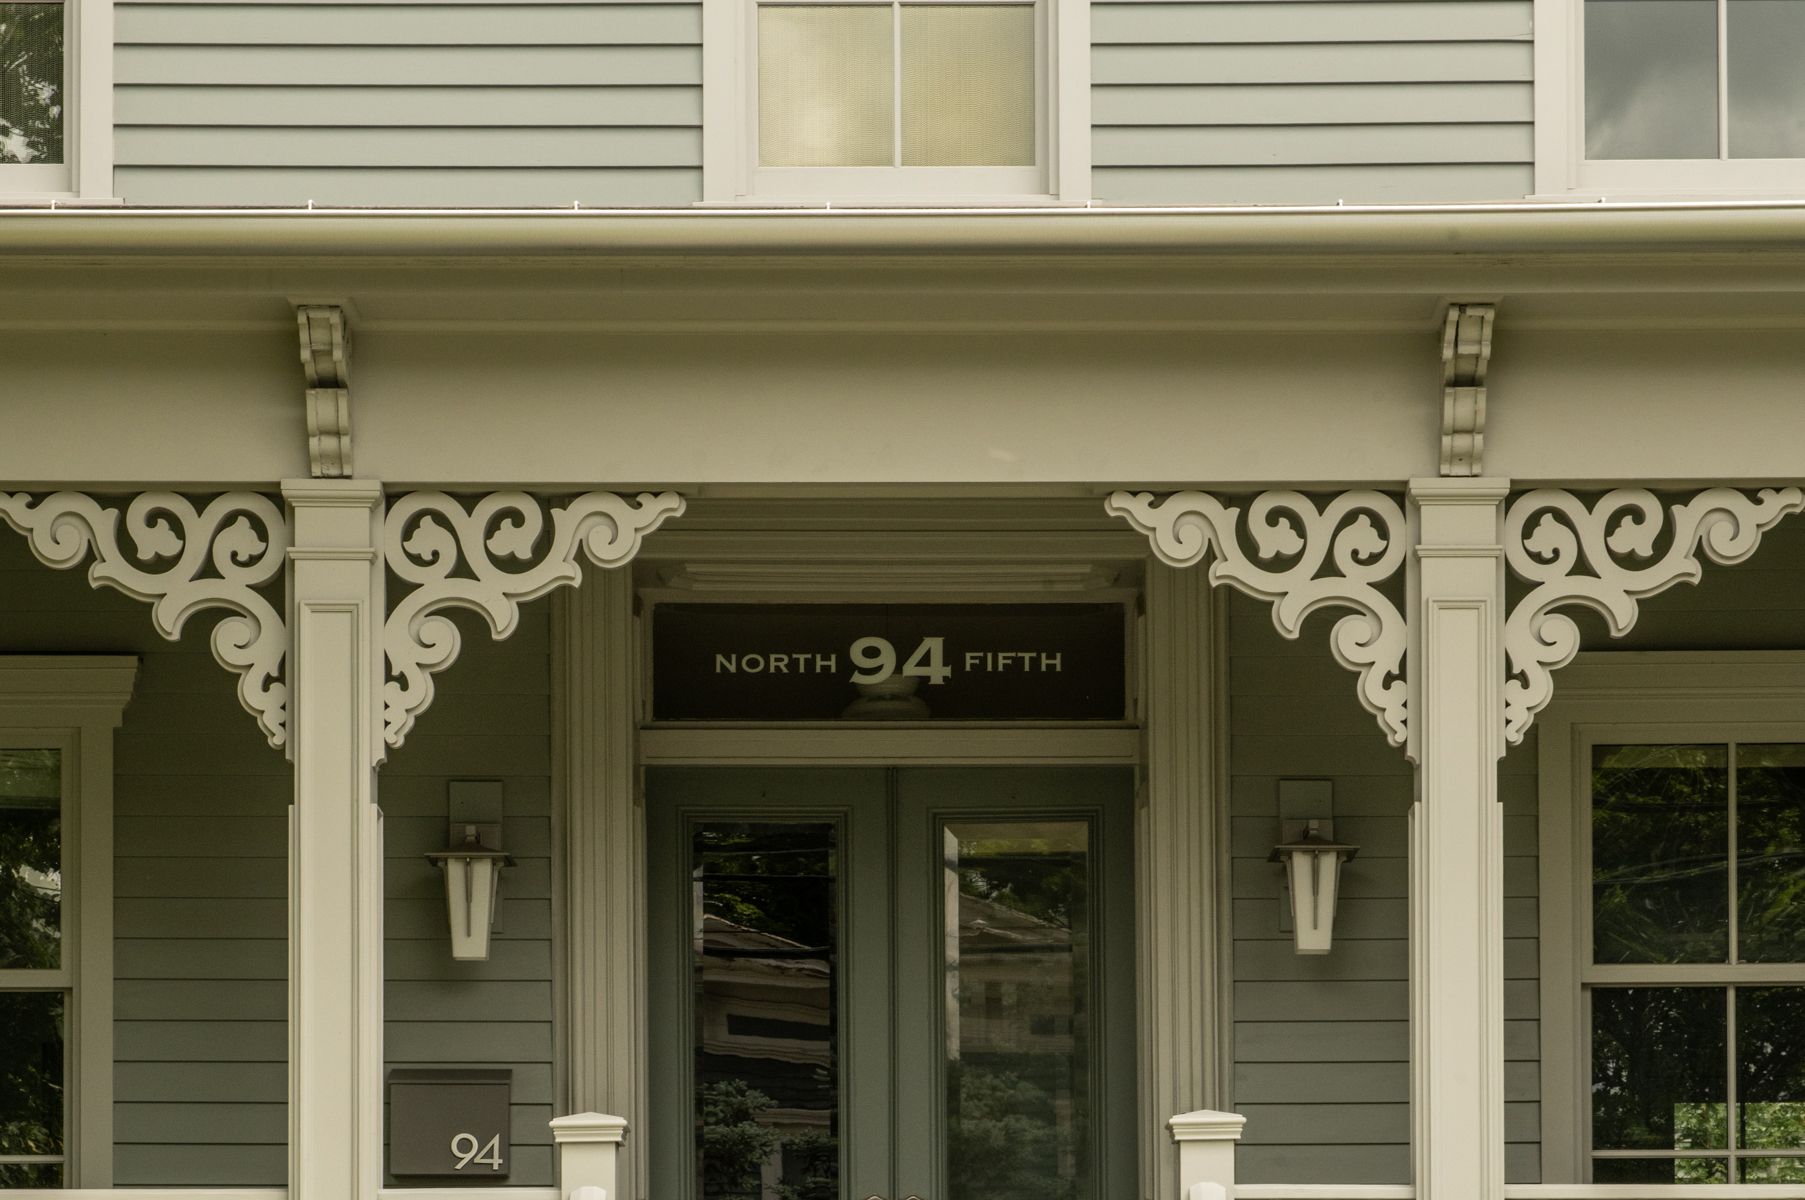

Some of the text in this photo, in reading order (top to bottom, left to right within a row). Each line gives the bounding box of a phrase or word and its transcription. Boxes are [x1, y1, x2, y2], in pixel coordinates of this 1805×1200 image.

[714, 636, 1062, 685] NORTH 94 FIFTH
[450, 1132, 504, 1170] 94
